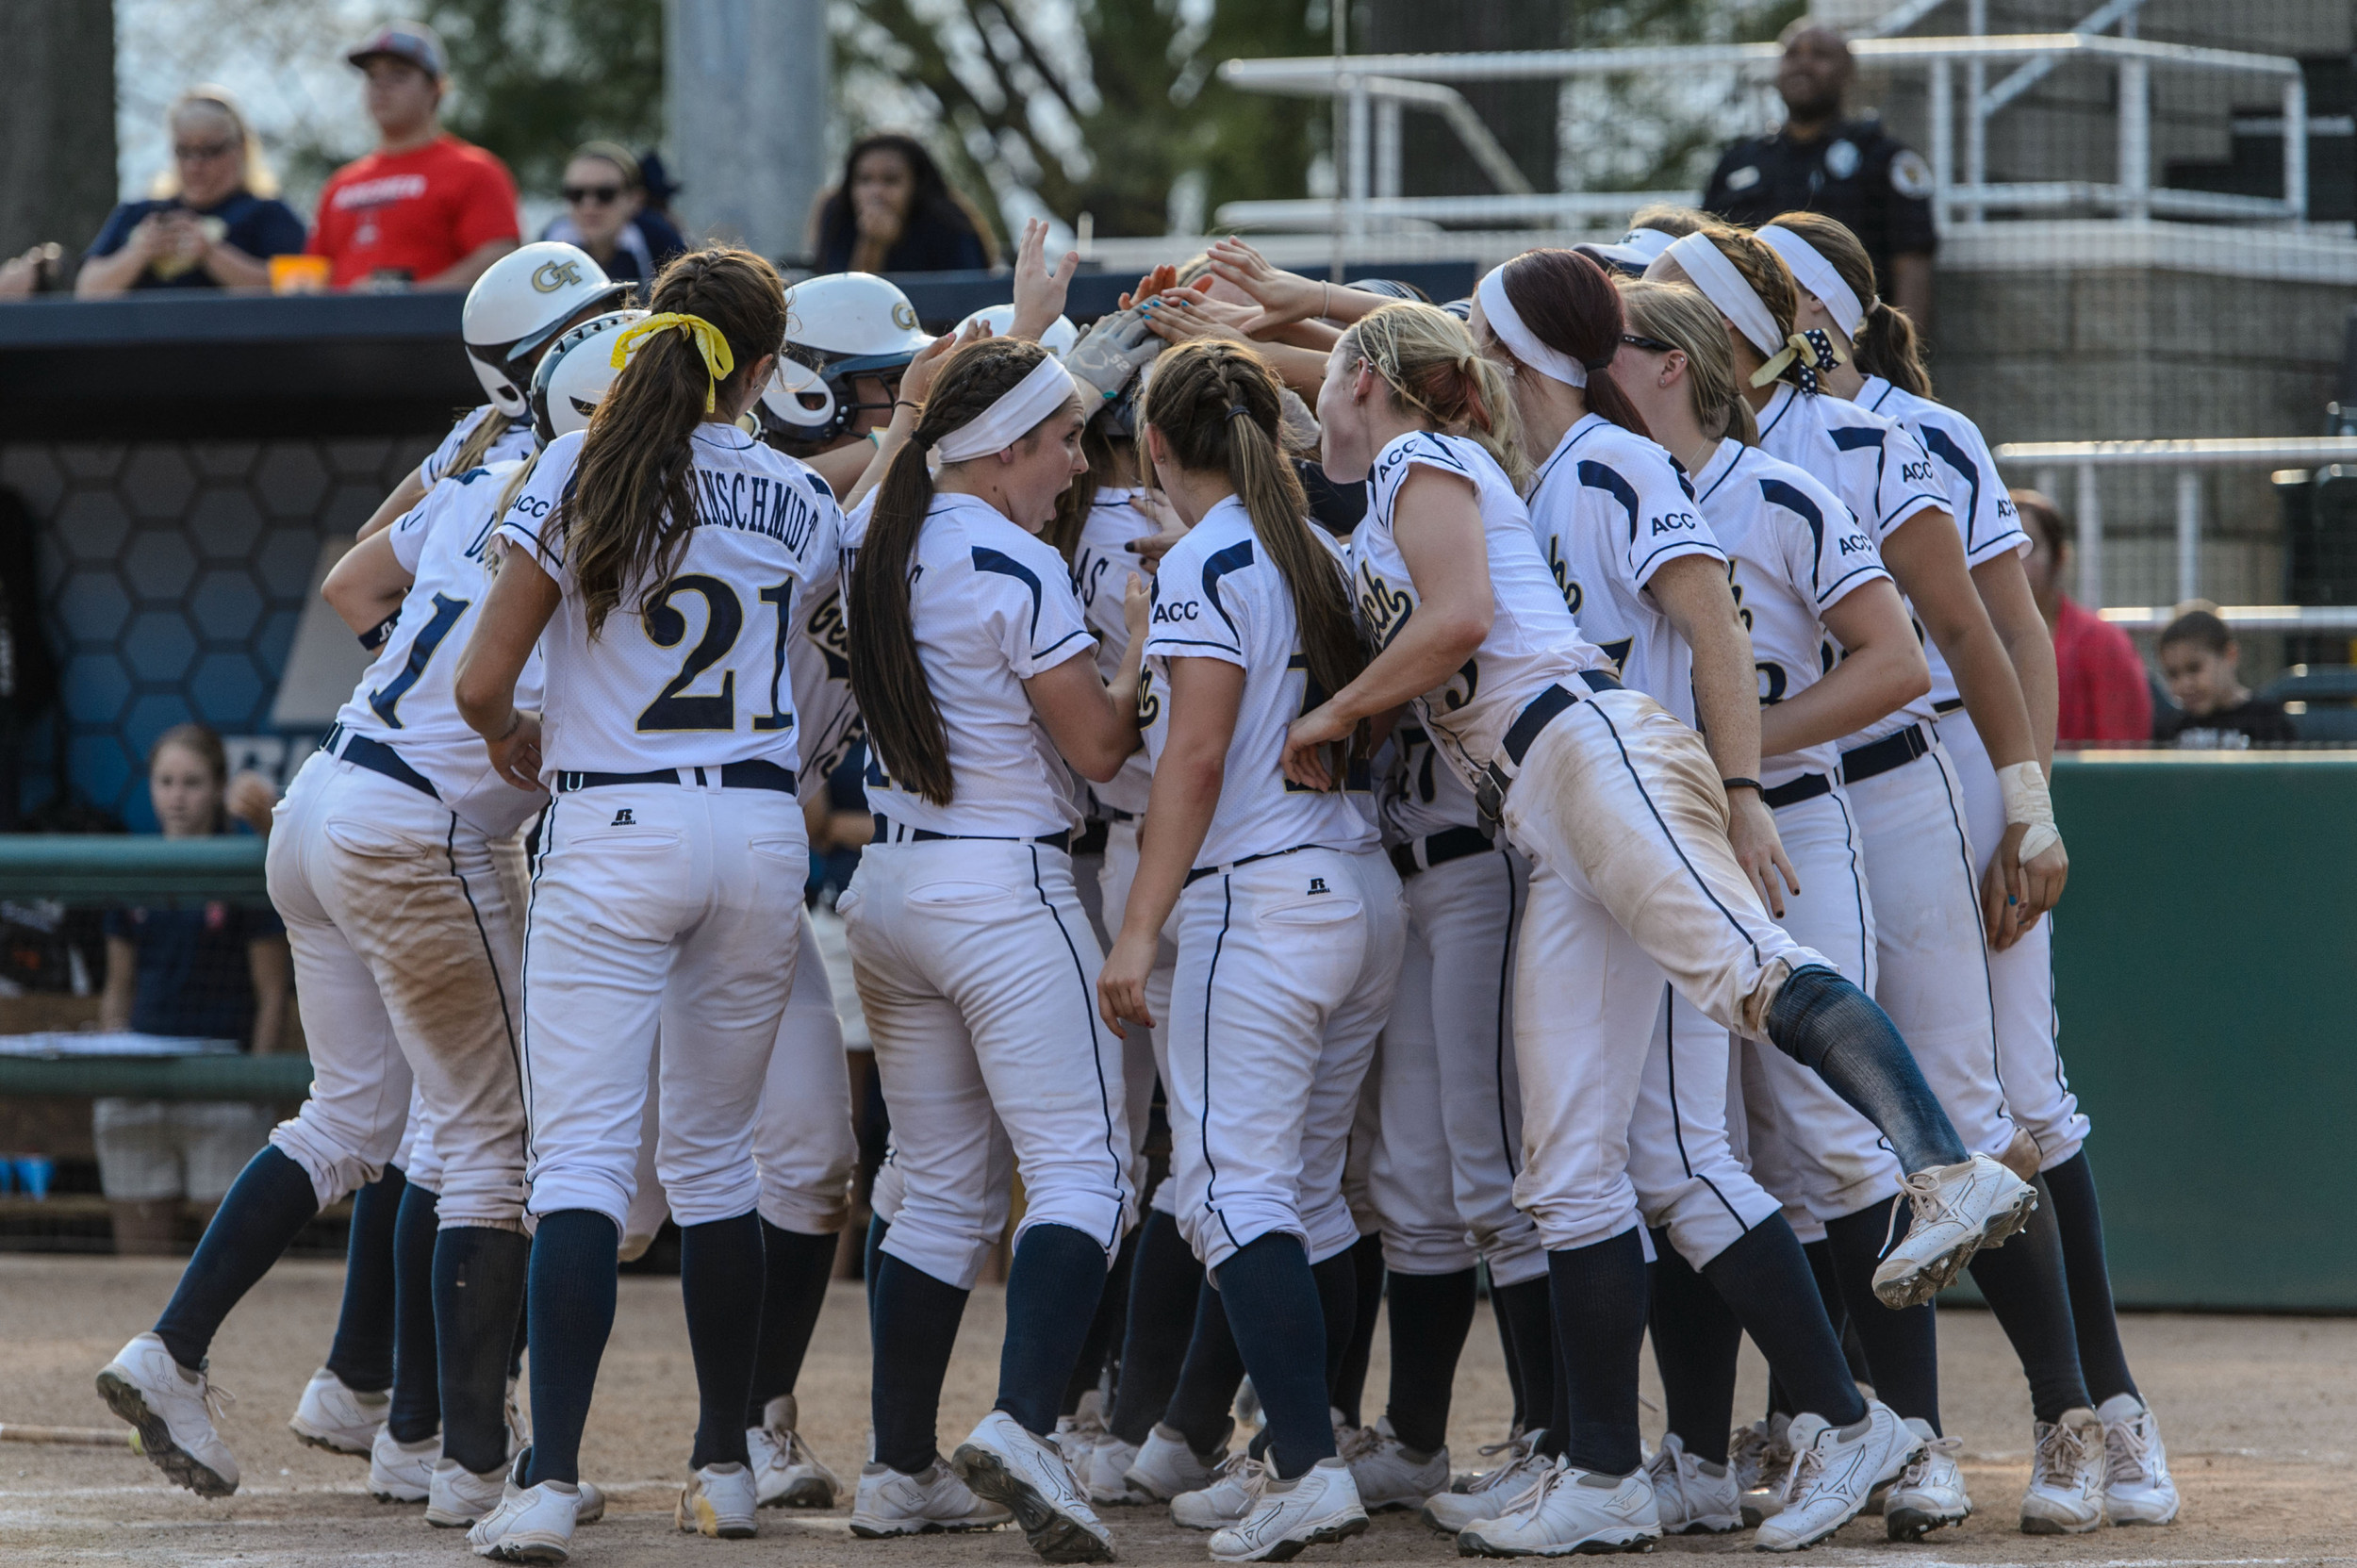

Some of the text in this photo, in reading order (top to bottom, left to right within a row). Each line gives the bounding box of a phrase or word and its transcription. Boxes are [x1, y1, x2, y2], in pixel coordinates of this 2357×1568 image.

[532, 259, 582, 293] GT
[1377, 438, 1420, 483] ACC
[1902, 461, 1934, 483] ACC
[1651, 512, 1696, 536] ACC
[1838, 535, 1871, 555] ACC
[1152, 601, 1199, 624] ACC
[635, 572, 795, 733] 21
